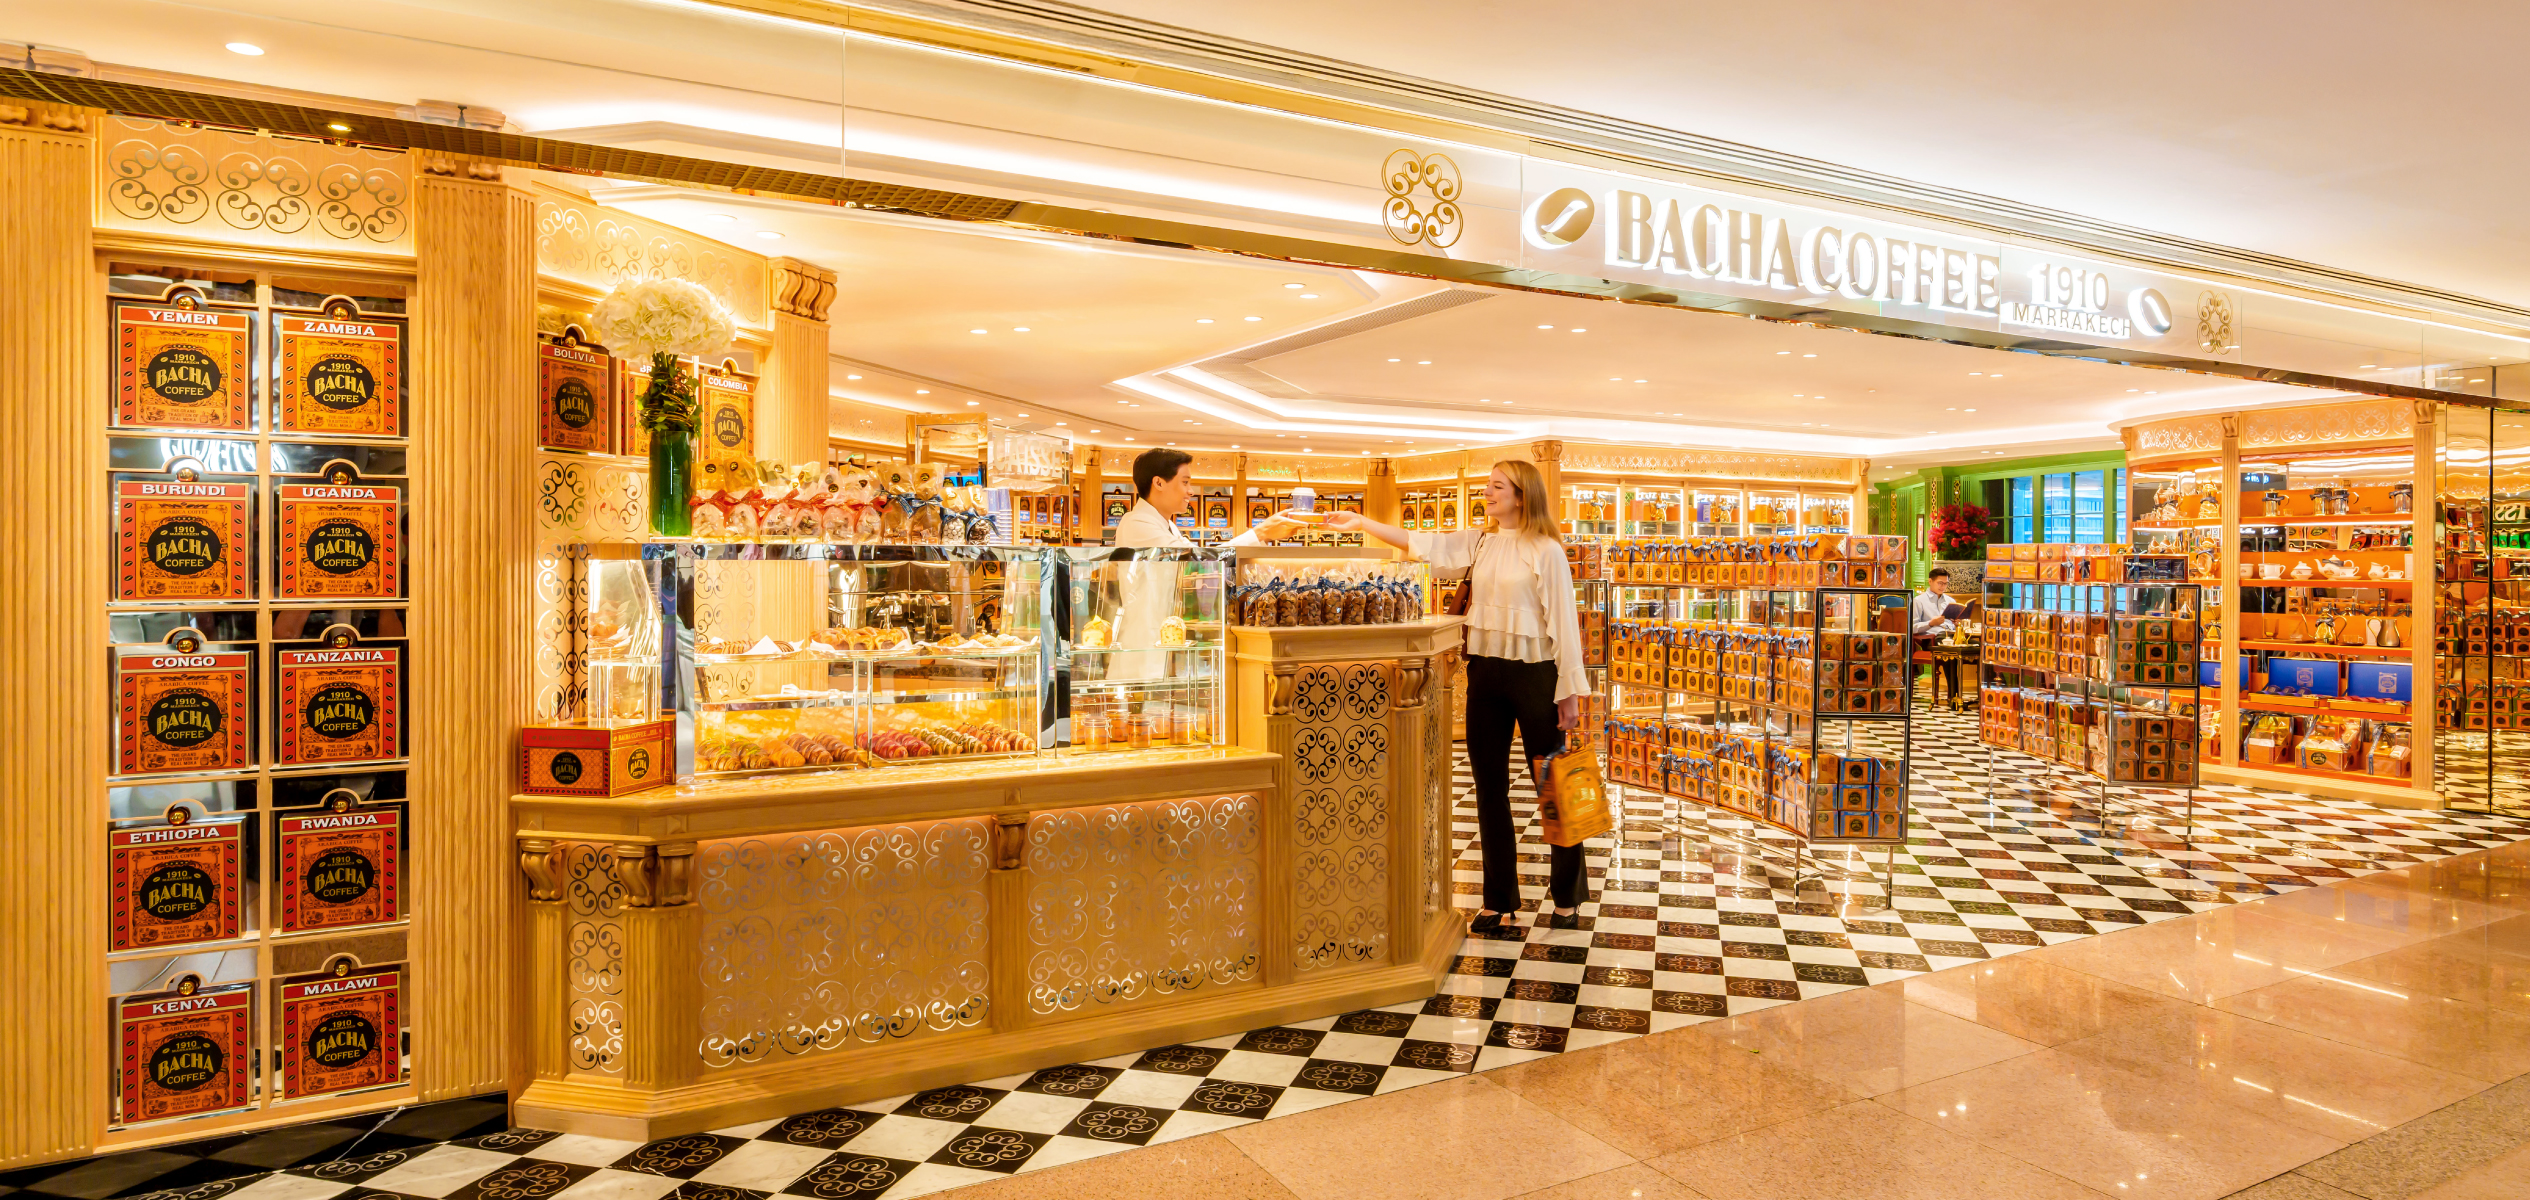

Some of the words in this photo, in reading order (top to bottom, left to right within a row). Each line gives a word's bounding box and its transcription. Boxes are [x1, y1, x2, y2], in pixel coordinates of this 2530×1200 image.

[1609, 189, 1799, 288] BACHA
[1806, 225, 1999, 316] COFFEE
[2034, 262, 2109, 311] 1910
[147, 310, 218, 325] YEMEN
[2012, 302, 2132, 338] MARRAKECH
[303, 321, 376, 336] ZAMBIA
[174, 353, 195, 361] 1910
[554, 348, 596, 364] BOLIVIA
[156, 365, 211, 390] BACHA
[708, 377, 749, 392] COLOMBIA
[164, 386, 203, 395] COFFEE
[315, 374, 366, 398] BACHA
[323, 393, 358, 402] COFFEE
[560, 396, 590, 419] BACHA
[564, 413, 586, 423] COFFEE
[717, 419, 741, 439] BACHA
[992, 431, 1062, 479] CAISSE
[141, 483, 226, 496] BURUNDI
[302, 487, 376, 498] UGANDA
[156, 538, 212, 561] BACHA
[314, 538, 365, 561] BACHA
[322, 558, 358, 566] COFFEE
[151, 656, 215, 667] CONGO
[292, 651, 384, 662] TANZANIA
[156, 710, 212, 734] BACHA
[314, 703, 365, 726] BACHA
[322, 722, 358, 731] COFFEE
[165, 730, 204, 739] COFFEE
[301, 814, 377, 829] RWANDA
[130, 827, 220, 843] ETHIOPIA
[331, 855, 350, 863] 1910
[166, 870, 187, 878] 1910
[315, 868, 366, 892] BACHA
[148, 882, 204, 909] BACHA
[323, 886, 358, 896] COFFEE
[157, 902, 196, 913] COFFEE
[304, 977, 377, 995] MALAWI
[152, 997, 217, 1013] KENYA
[332, 1019, 351, 1027] 1910
[176, 1040, 196, 1049] 1910
[316, 1032, 367, 1058] BACHA
[324, 1049, 360, 1061] COFFEE
[158, 1053, 213, 1080] BACHA
[166, 1071, 205, 1084] COFFEE
